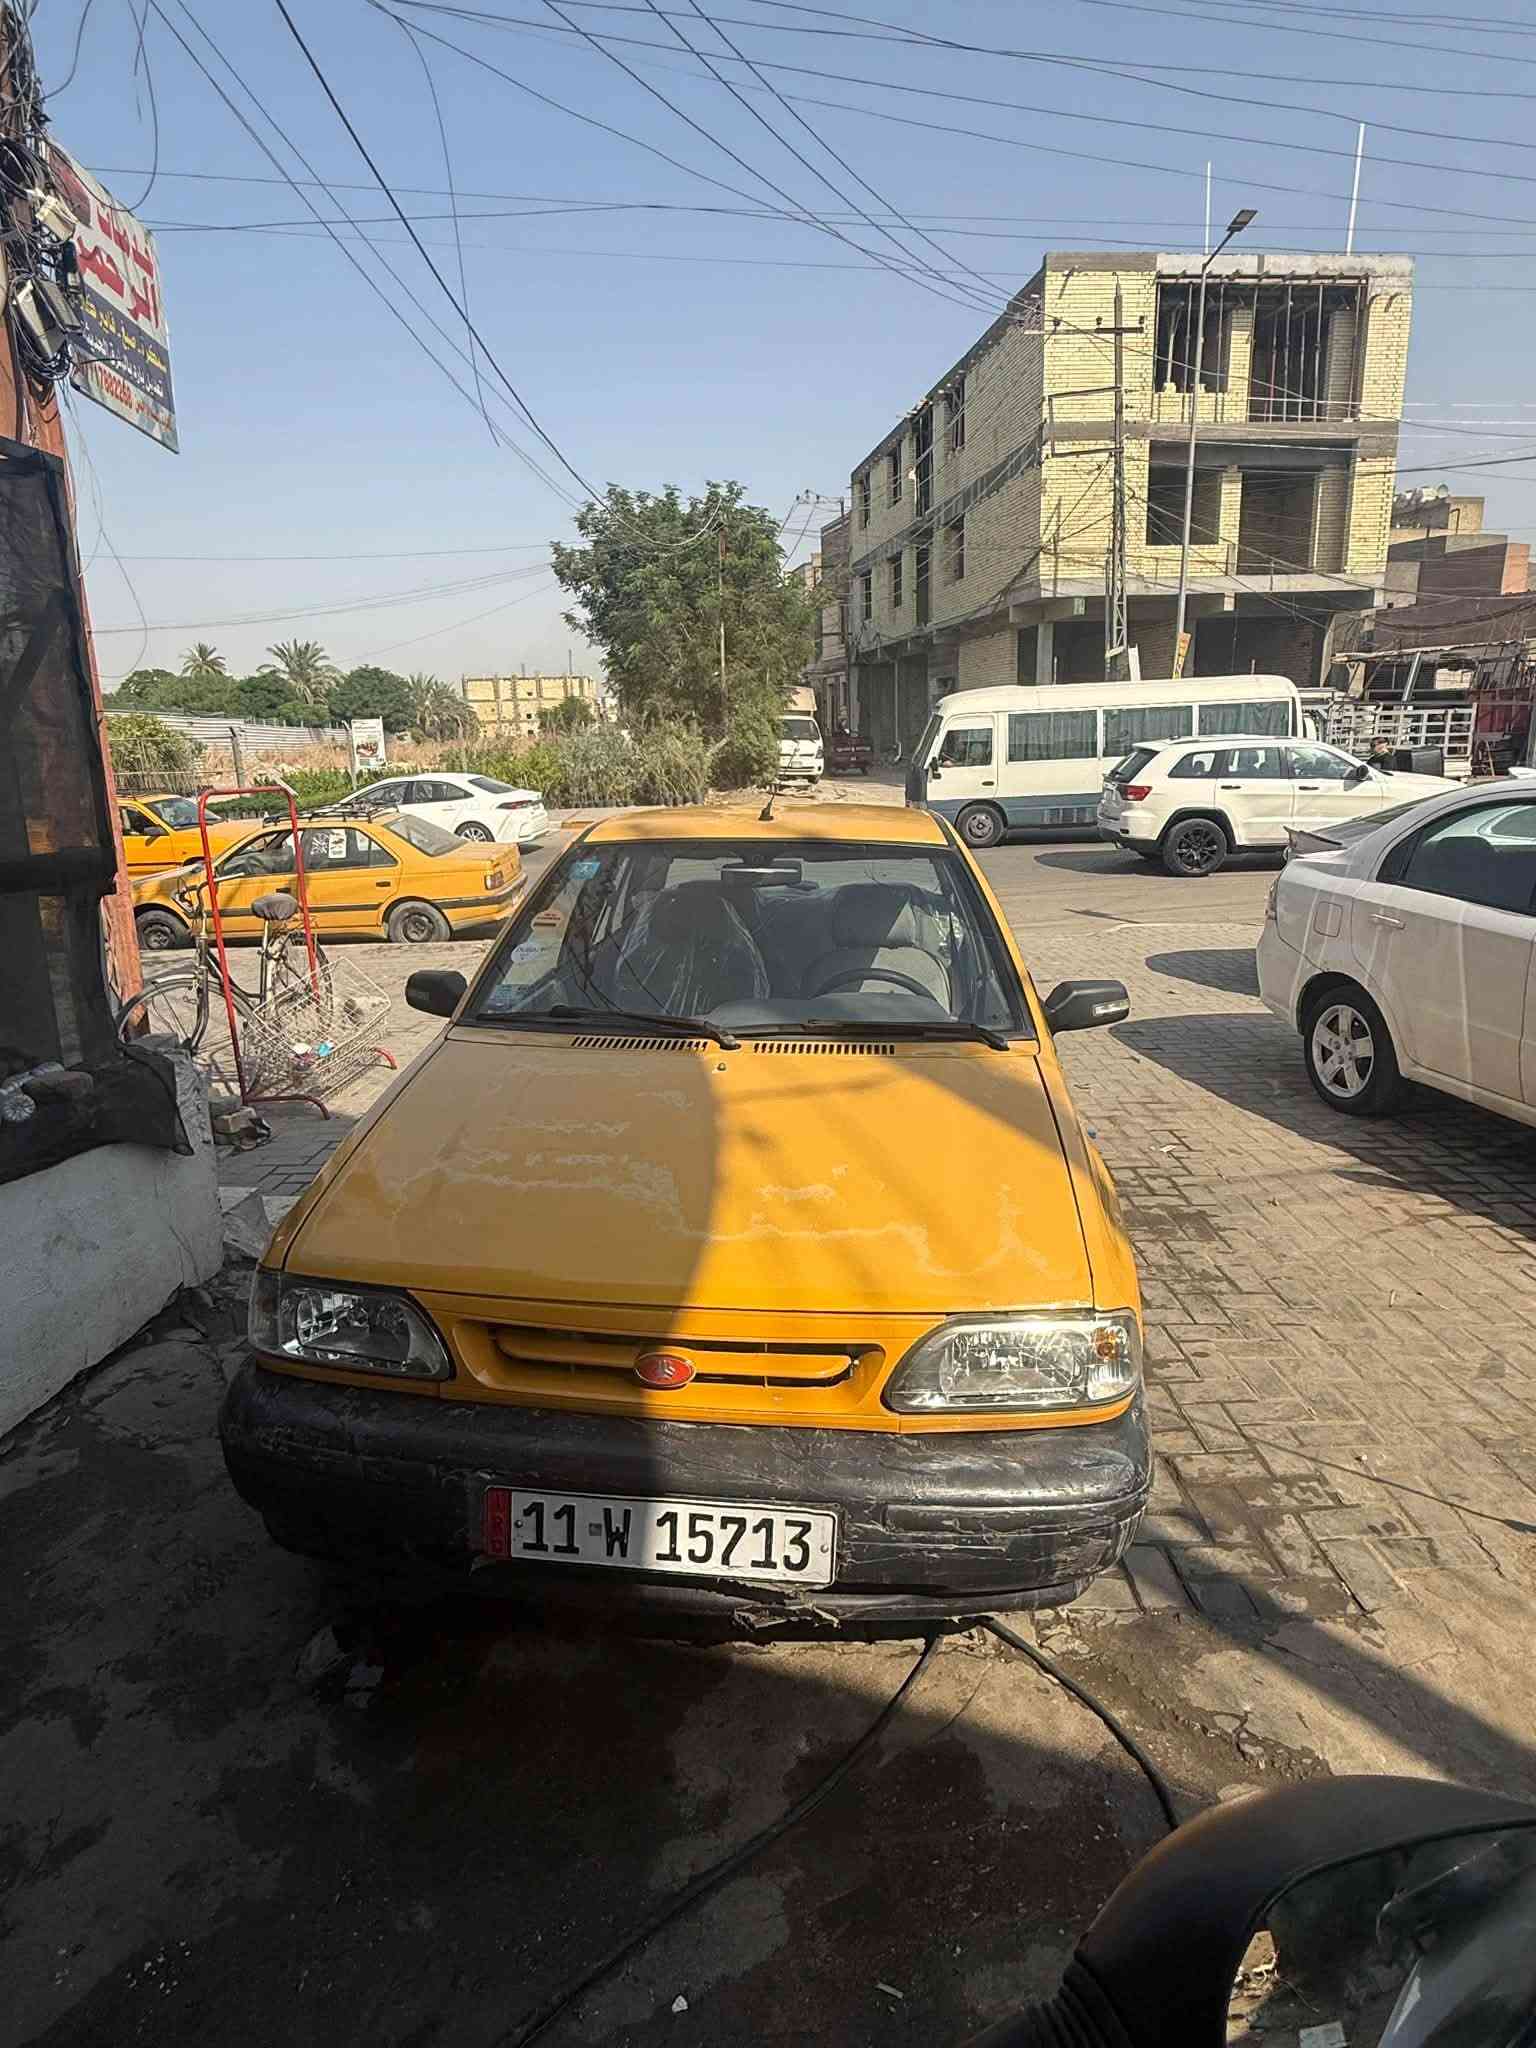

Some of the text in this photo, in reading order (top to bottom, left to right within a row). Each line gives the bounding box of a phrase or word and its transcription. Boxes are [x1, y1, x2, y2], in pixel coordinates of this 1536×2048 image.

[522, 1501, 811, 1572] 11 W 15713
